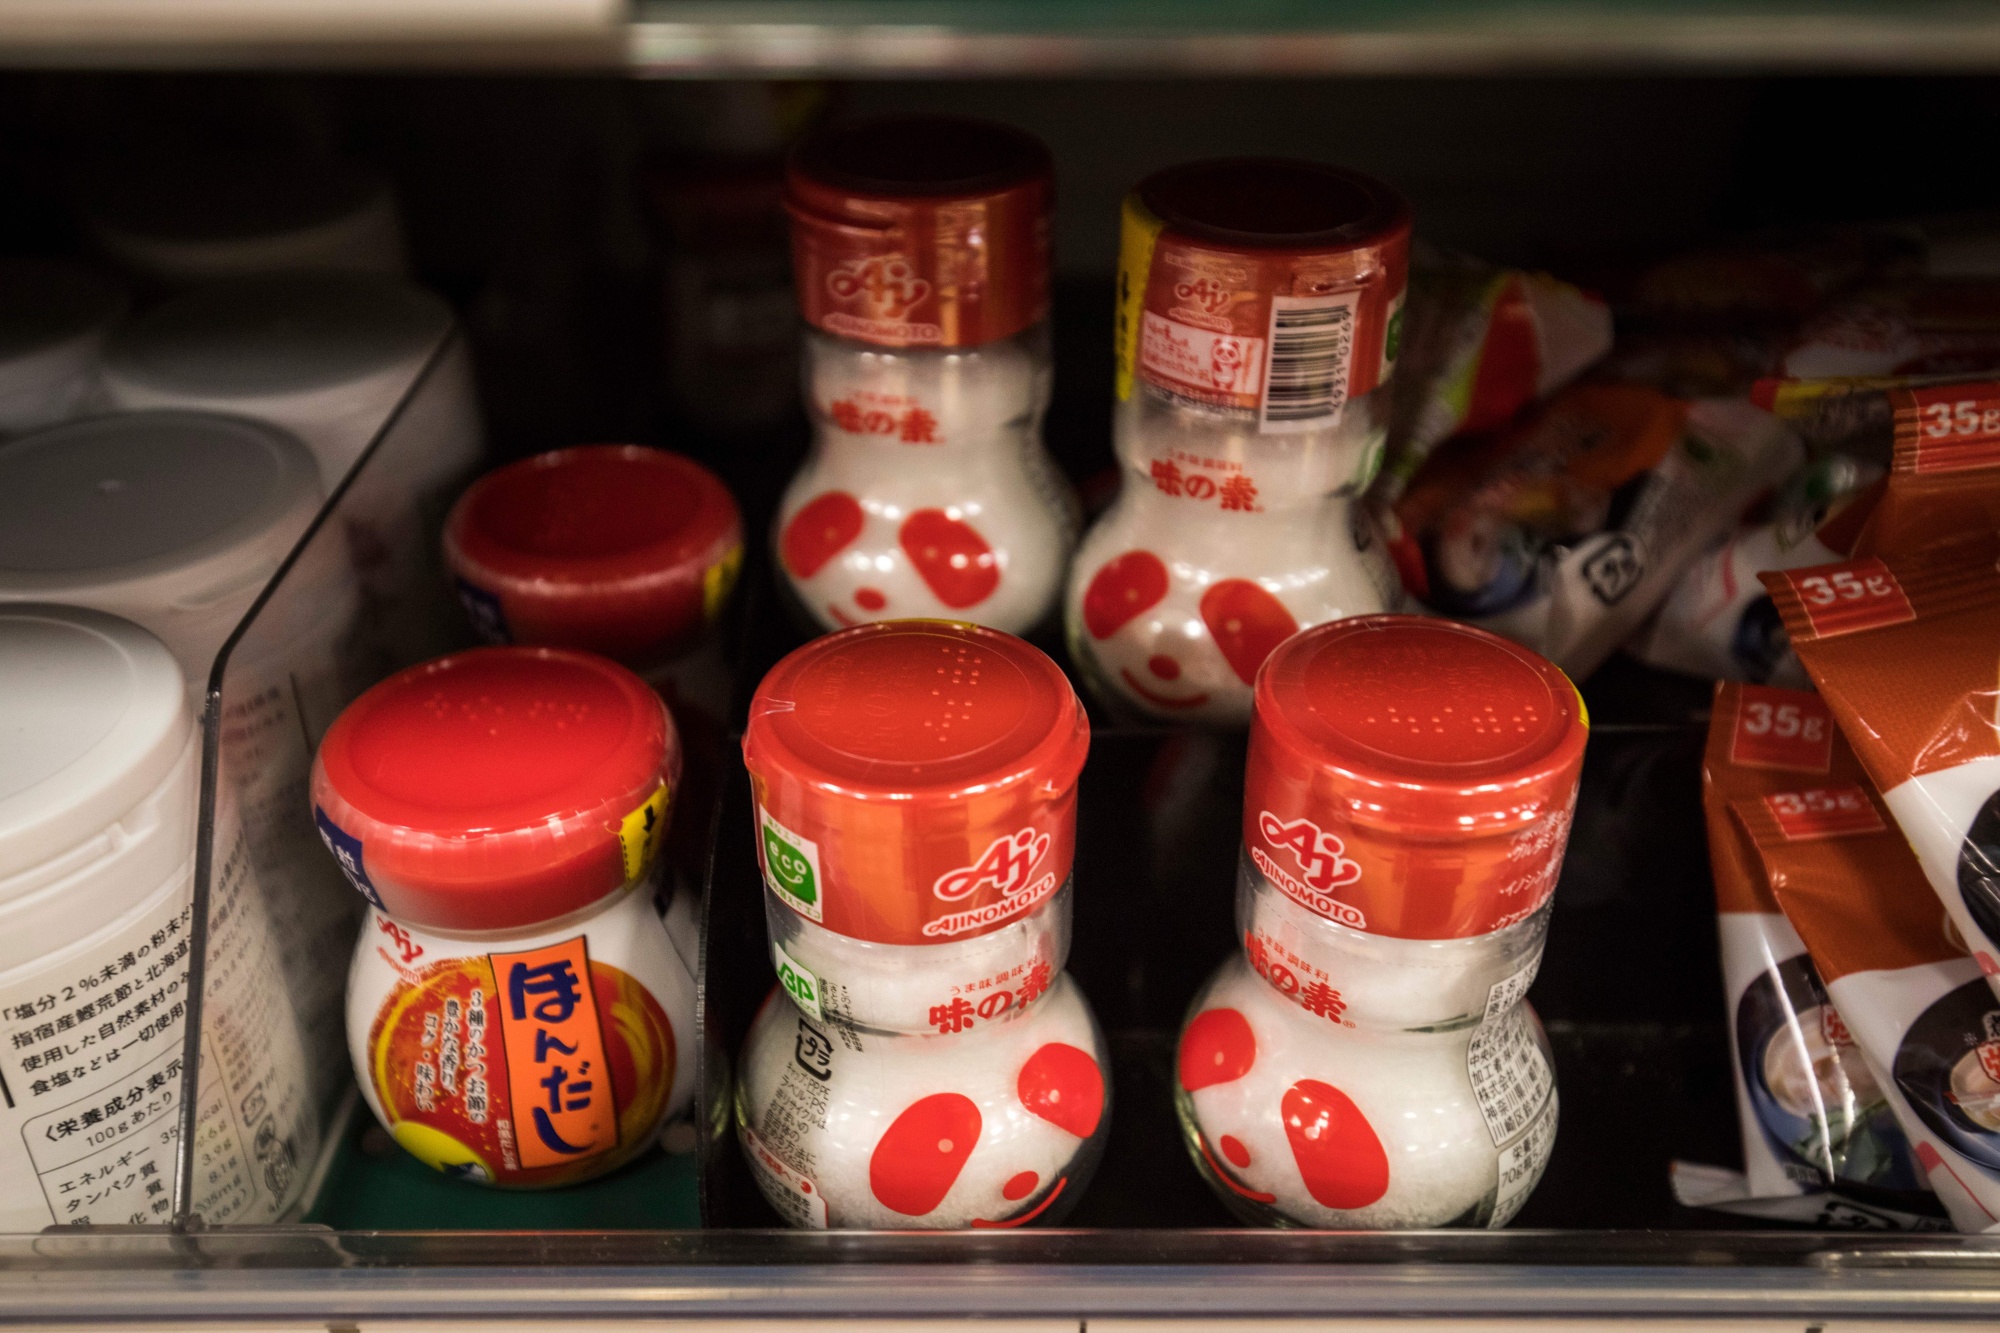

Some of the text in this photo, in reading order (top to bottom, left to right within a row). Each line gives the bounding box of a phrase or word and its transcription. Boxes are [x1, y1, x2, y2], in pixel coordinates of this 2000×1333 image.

[1149, 457, 1258, 512] 味の素
[1802, 571, 1893, 605] 35g
[1745, 702, 1824, 741] 35g
[769, 840, 807, 876] eco
[934, 828, 1050, 900] Aj
[1260, 812, 1361, 892] Aj
[923, 873, 1055, 936] AJINOMOTO
[1253, 847, 1365, 929] AJINOMOTO
[11, 933, 191, 1050] 指宿産鰹荒節と北海道
[929, 960, 1050, 1034] 味の素
[1244, 928, 1347, 1024] 味の素
[508, 959, 597, 1154] ほんだし
[804, 1036, 831, 1067] プラ
[86, 1091, 173, 1147] 100gあたり
[59, 1146, 150, 1194] エネルギー
[66, 1160, 159, 1213] タンパク質
